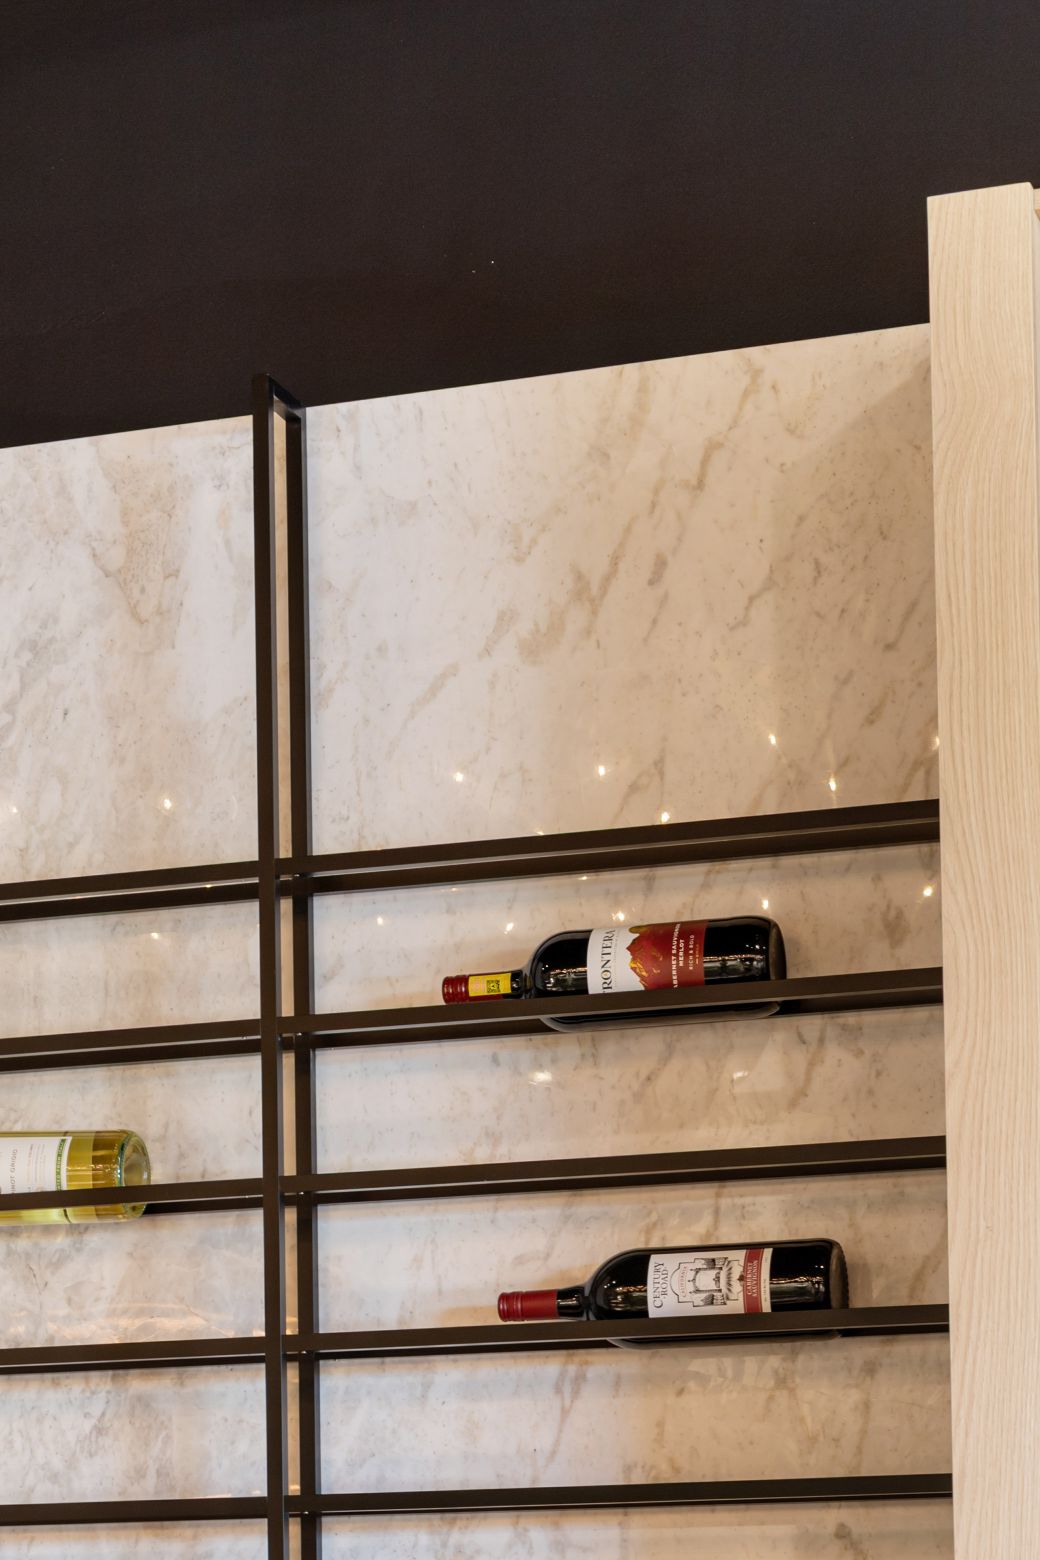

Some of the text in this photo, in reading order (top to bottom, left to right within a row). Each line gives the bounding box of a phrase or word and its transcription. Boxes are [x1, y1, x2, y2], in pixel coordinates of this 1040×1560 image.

[601, 930, 616, 993] RONTERA
[652, 1262, 665, 1308] CENTURY
[679, 1266, 687, 1298] CALIFORNIA
